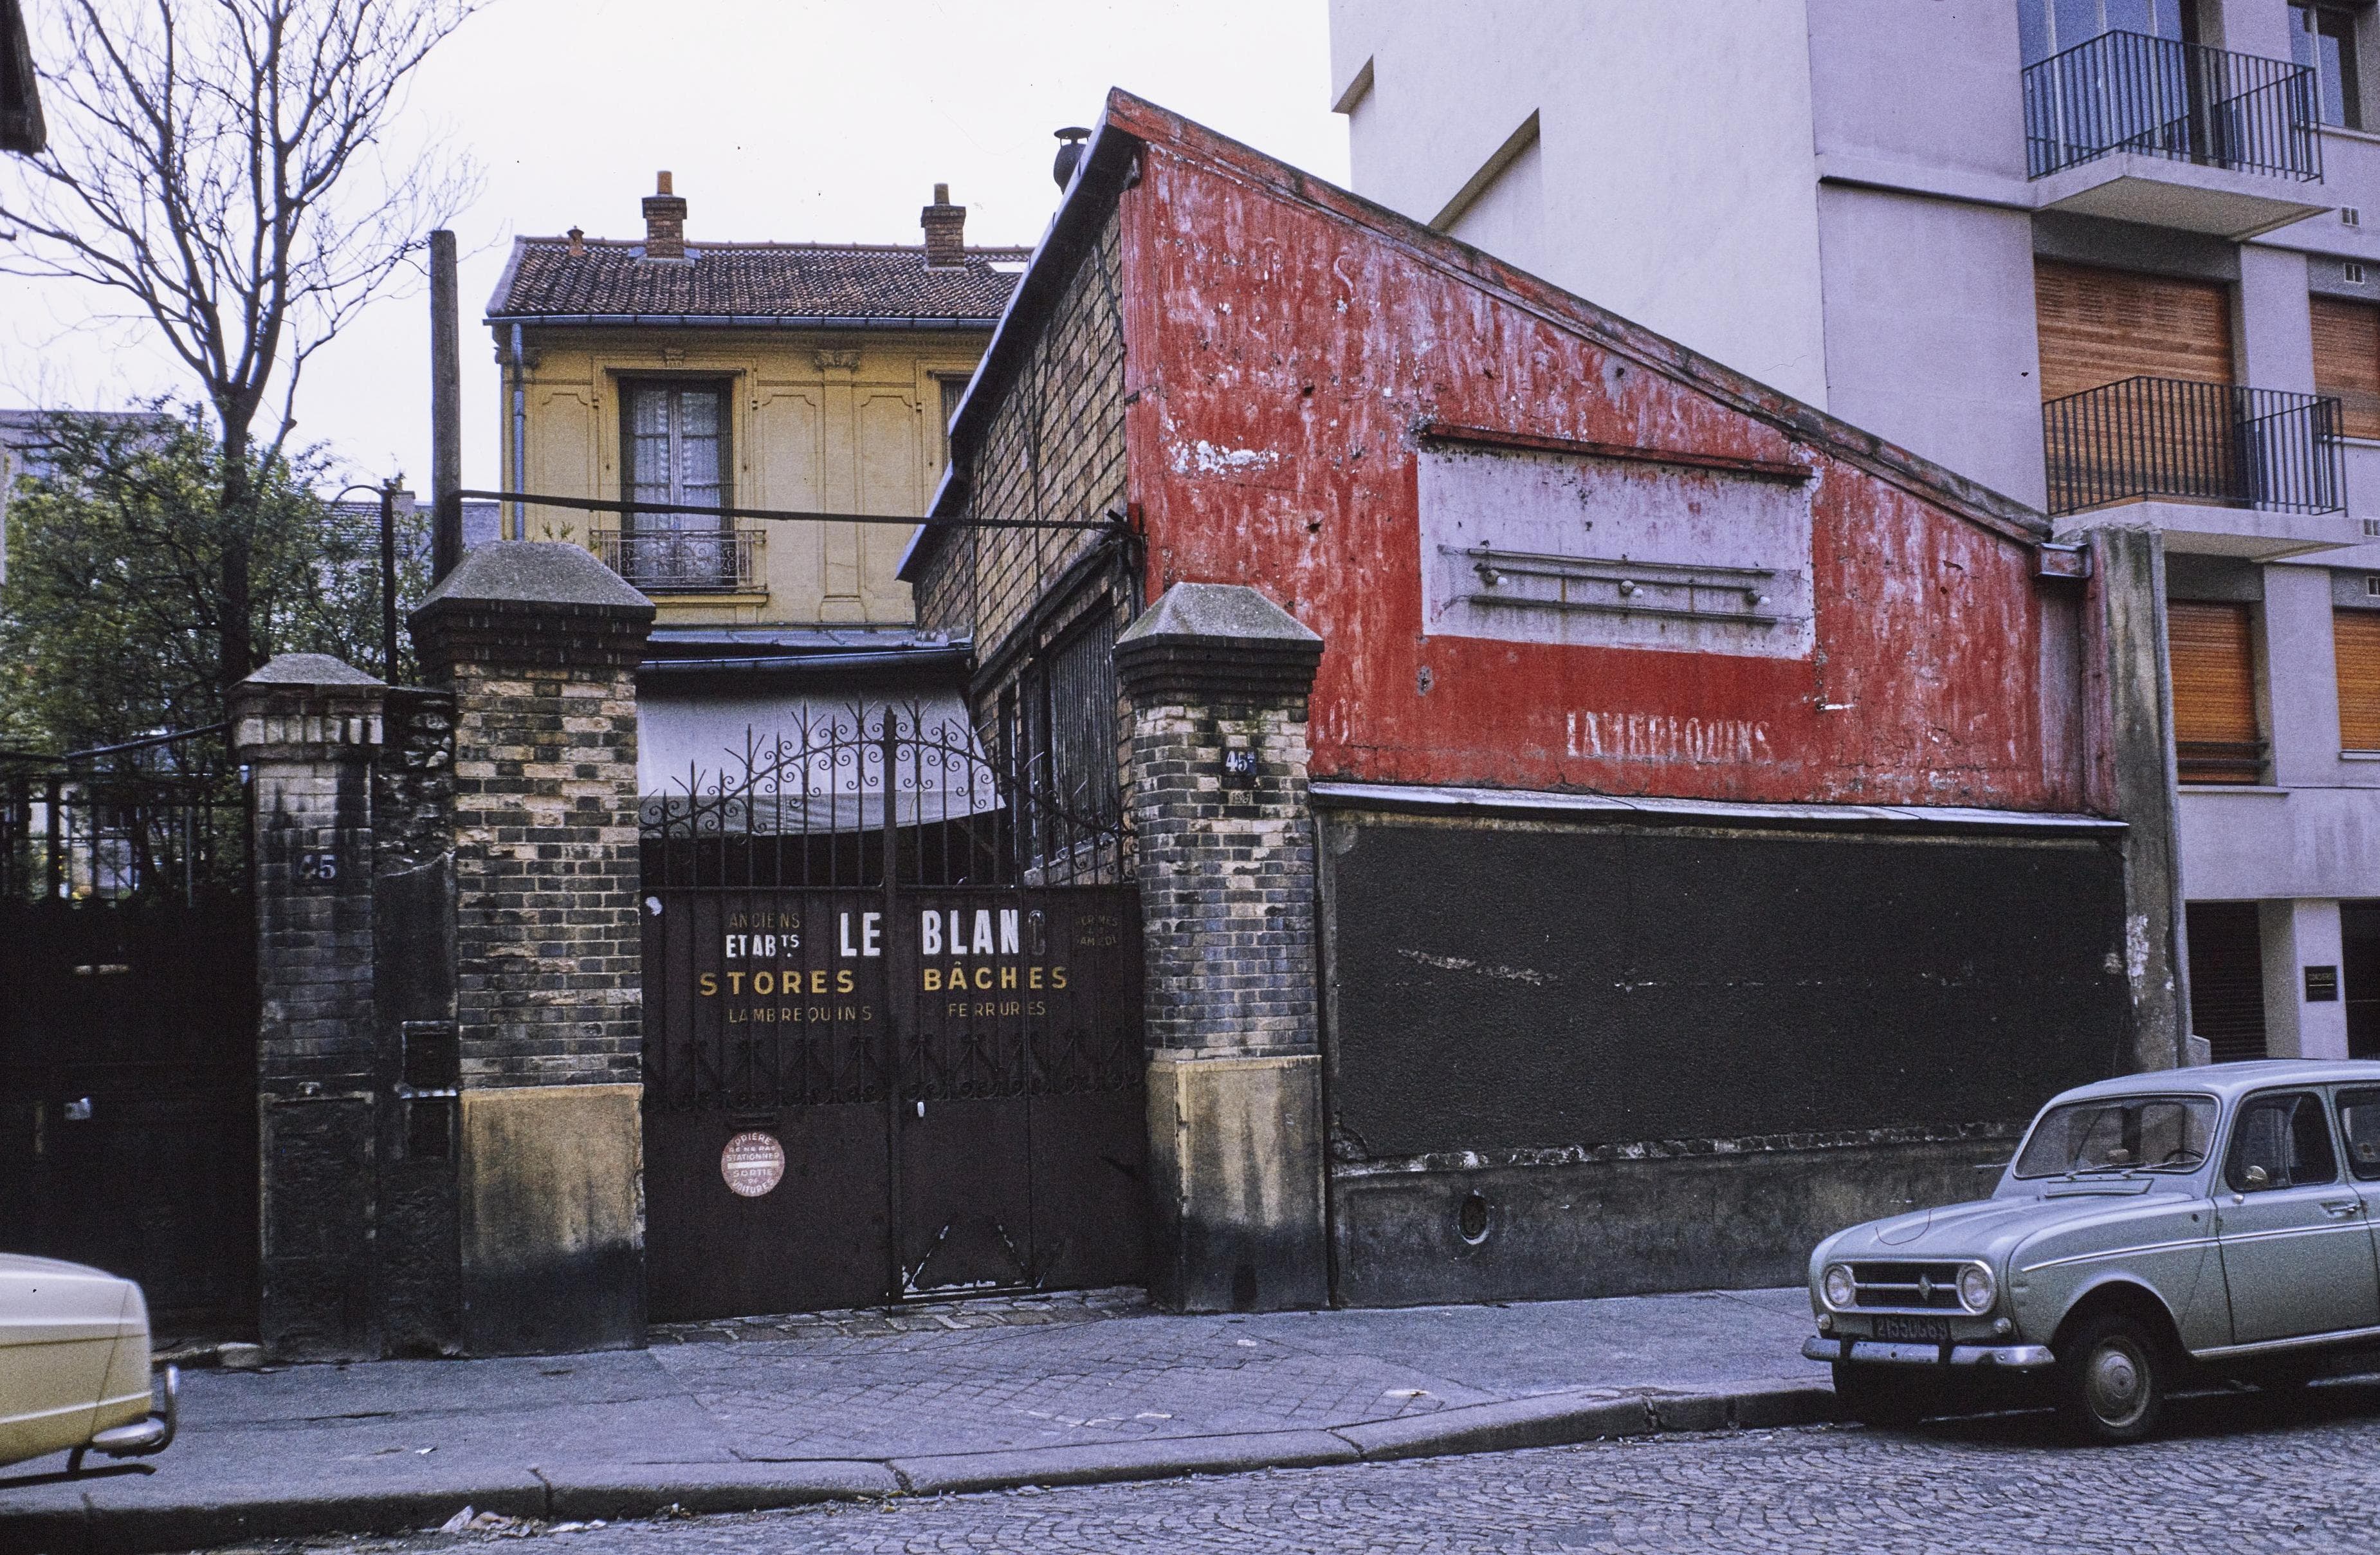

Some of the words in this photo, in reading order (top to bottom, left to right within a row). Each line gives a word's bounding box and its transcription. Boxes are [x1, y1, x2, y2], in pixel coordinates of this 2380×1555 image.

[729, 912, 800, 929] ANCIENS
[840, 912, 881, 957] LE
[699, 969, 854, 996] STORES
[924, 961, 1068, 991] BÂCHES
[729, 1006, 872, 1024] LAMBREQUINS
[949, 1001, 1046, 1017] FERRURES
[733, 1169, 773, 1177] SORTIE
